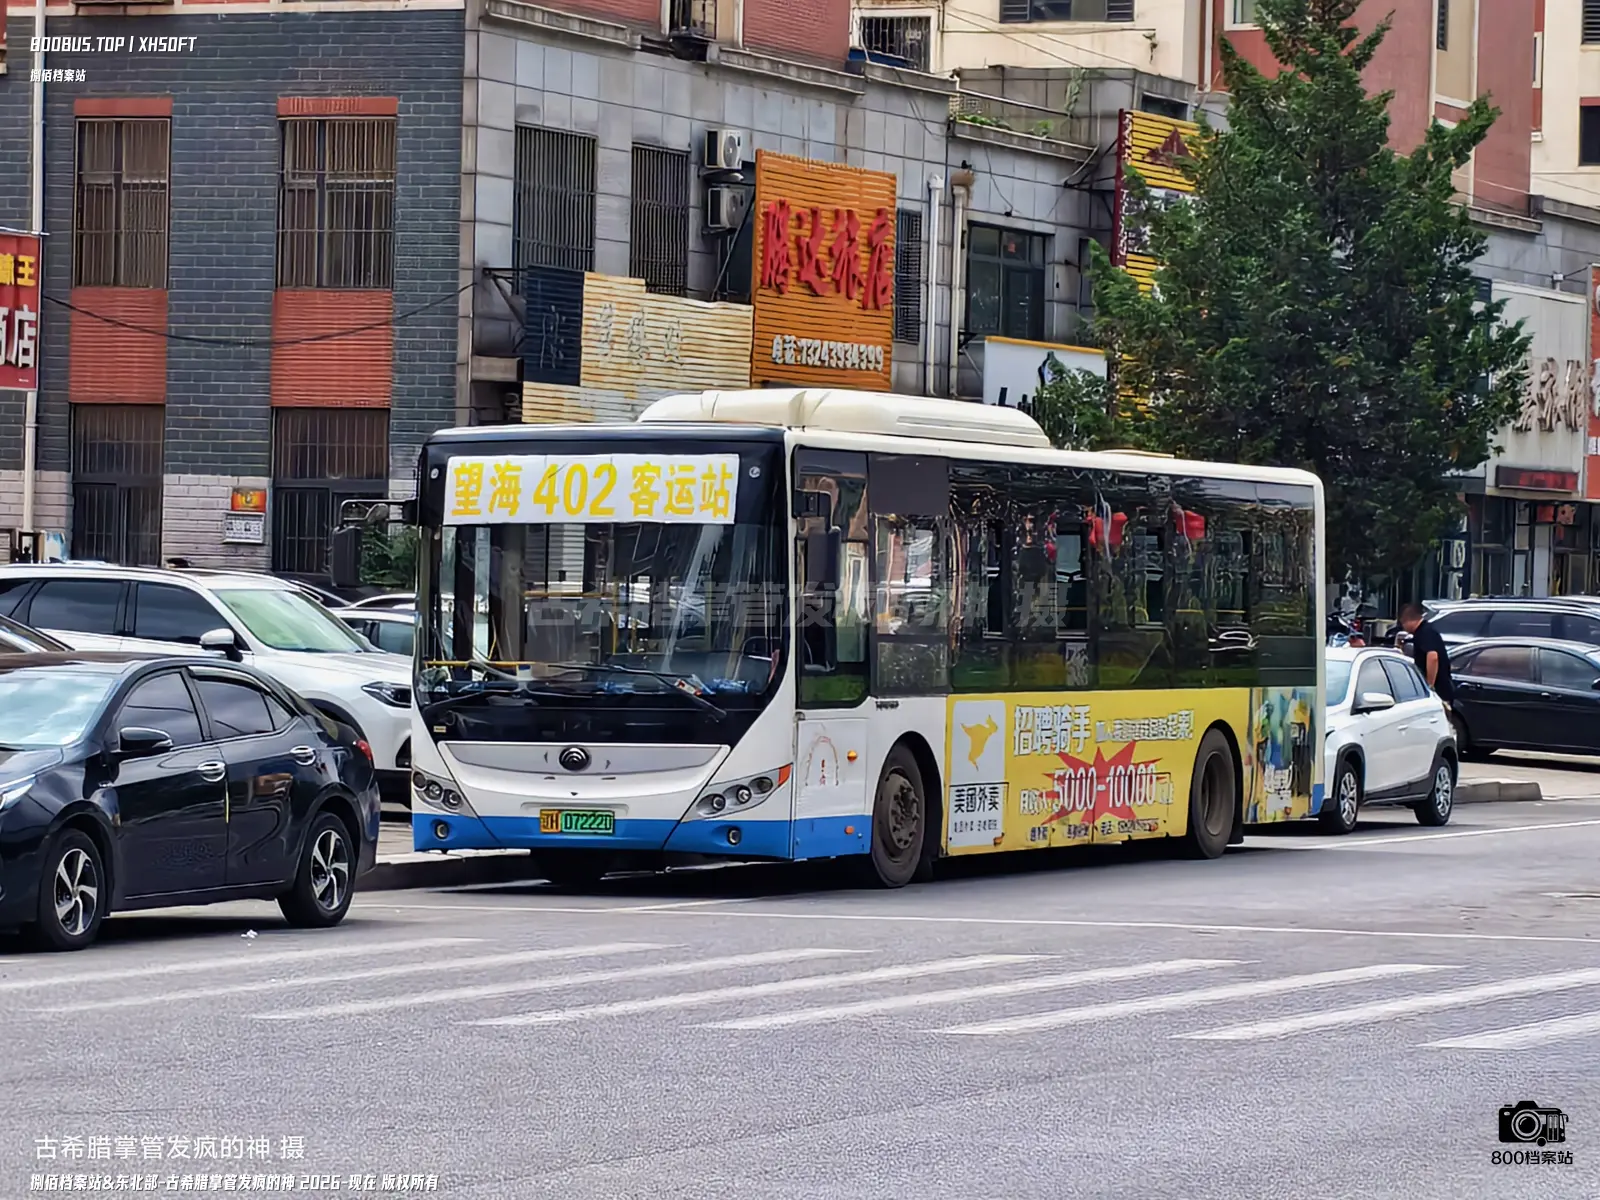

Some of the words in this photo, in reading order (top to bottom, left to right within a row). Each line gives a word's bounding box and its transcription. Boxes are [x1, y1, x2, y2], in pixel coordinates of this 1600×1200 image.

[450, 462, 522, 517] 望海
[533, 463, 617, 516] 402
[629, 461, 733, 518] 客运站
[1014, 704, 1091, 756] 招聘骑手
